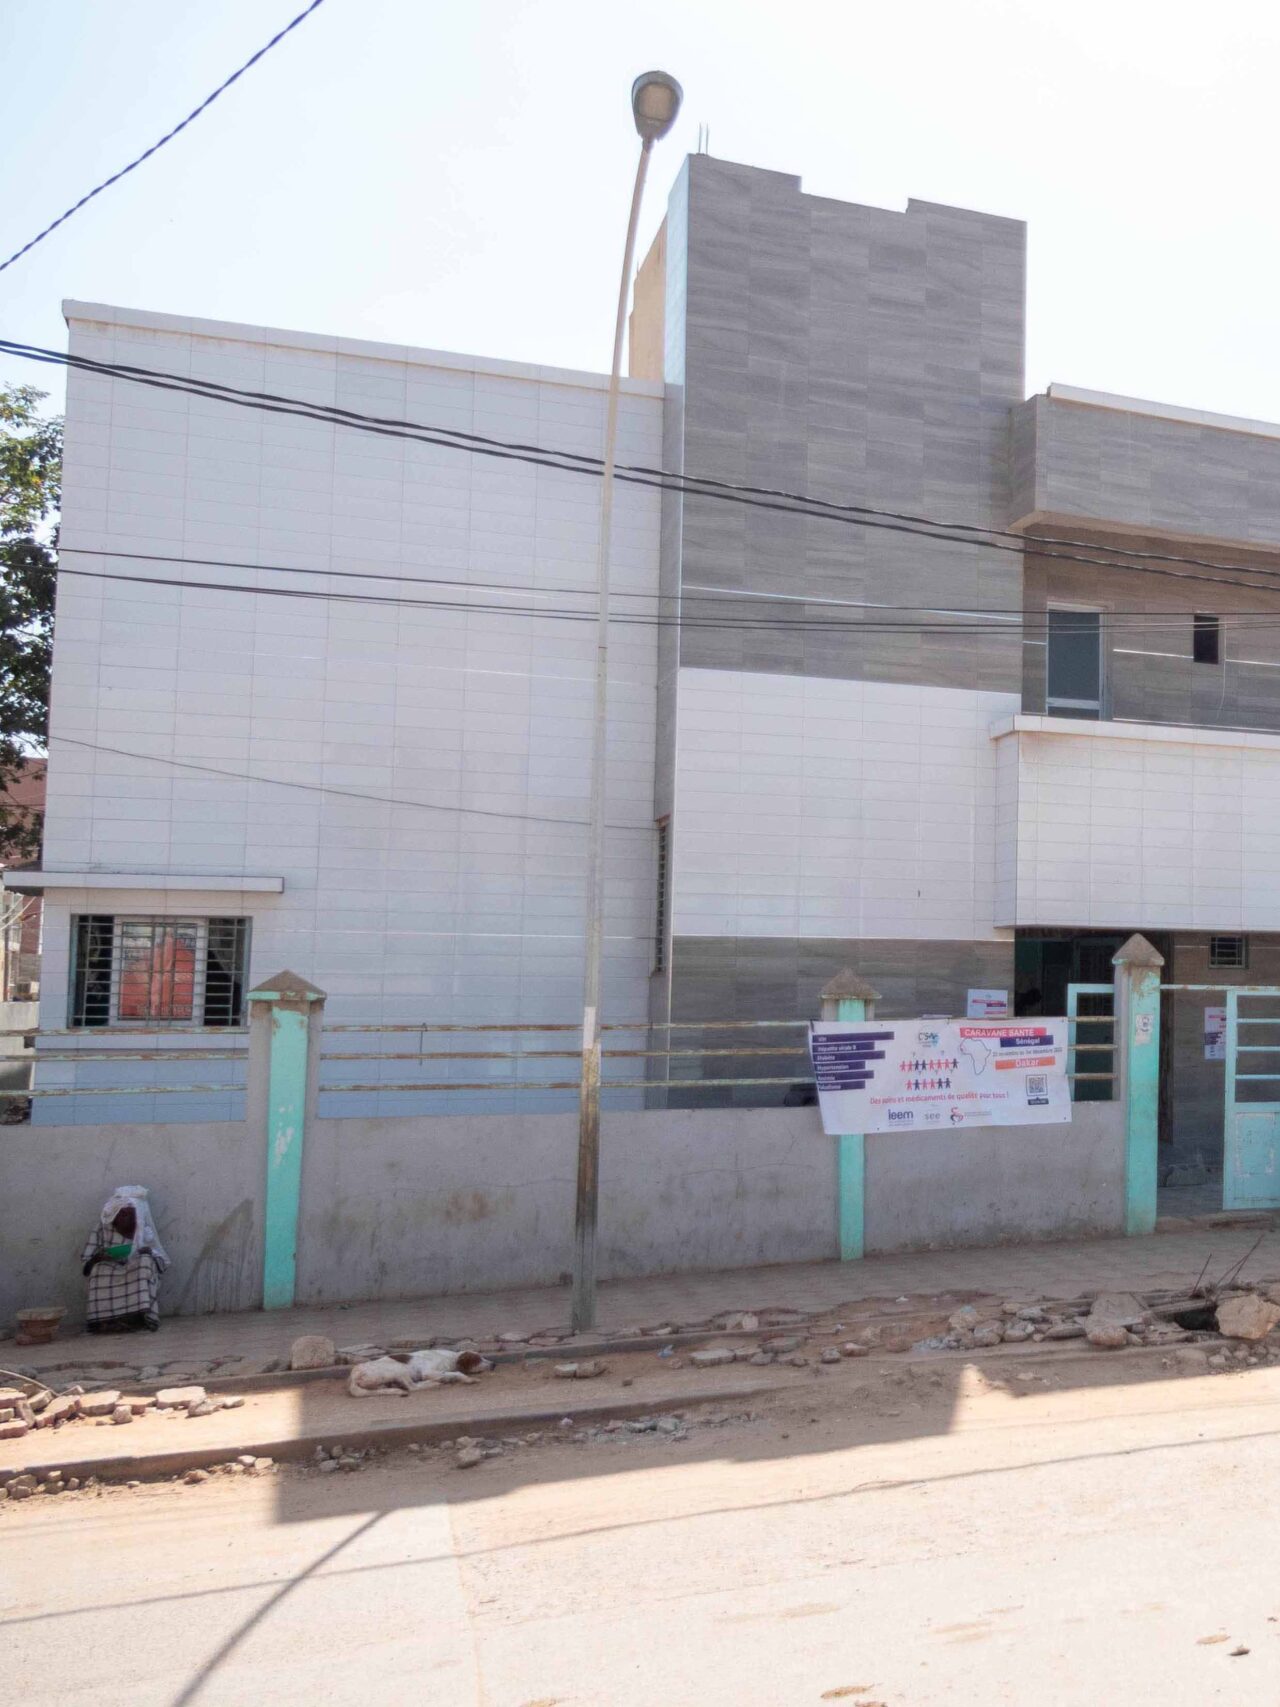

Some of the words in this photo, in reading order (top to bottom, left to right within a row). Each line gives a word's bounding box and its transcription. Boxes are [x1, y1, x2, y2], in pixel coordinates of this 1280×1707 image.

[964, 1028, 1007, 1037] CARAVANE
[1015, 1037, 1041, 1046] Sénégal
[1015, 1058, 1040, 1068] Dakar
